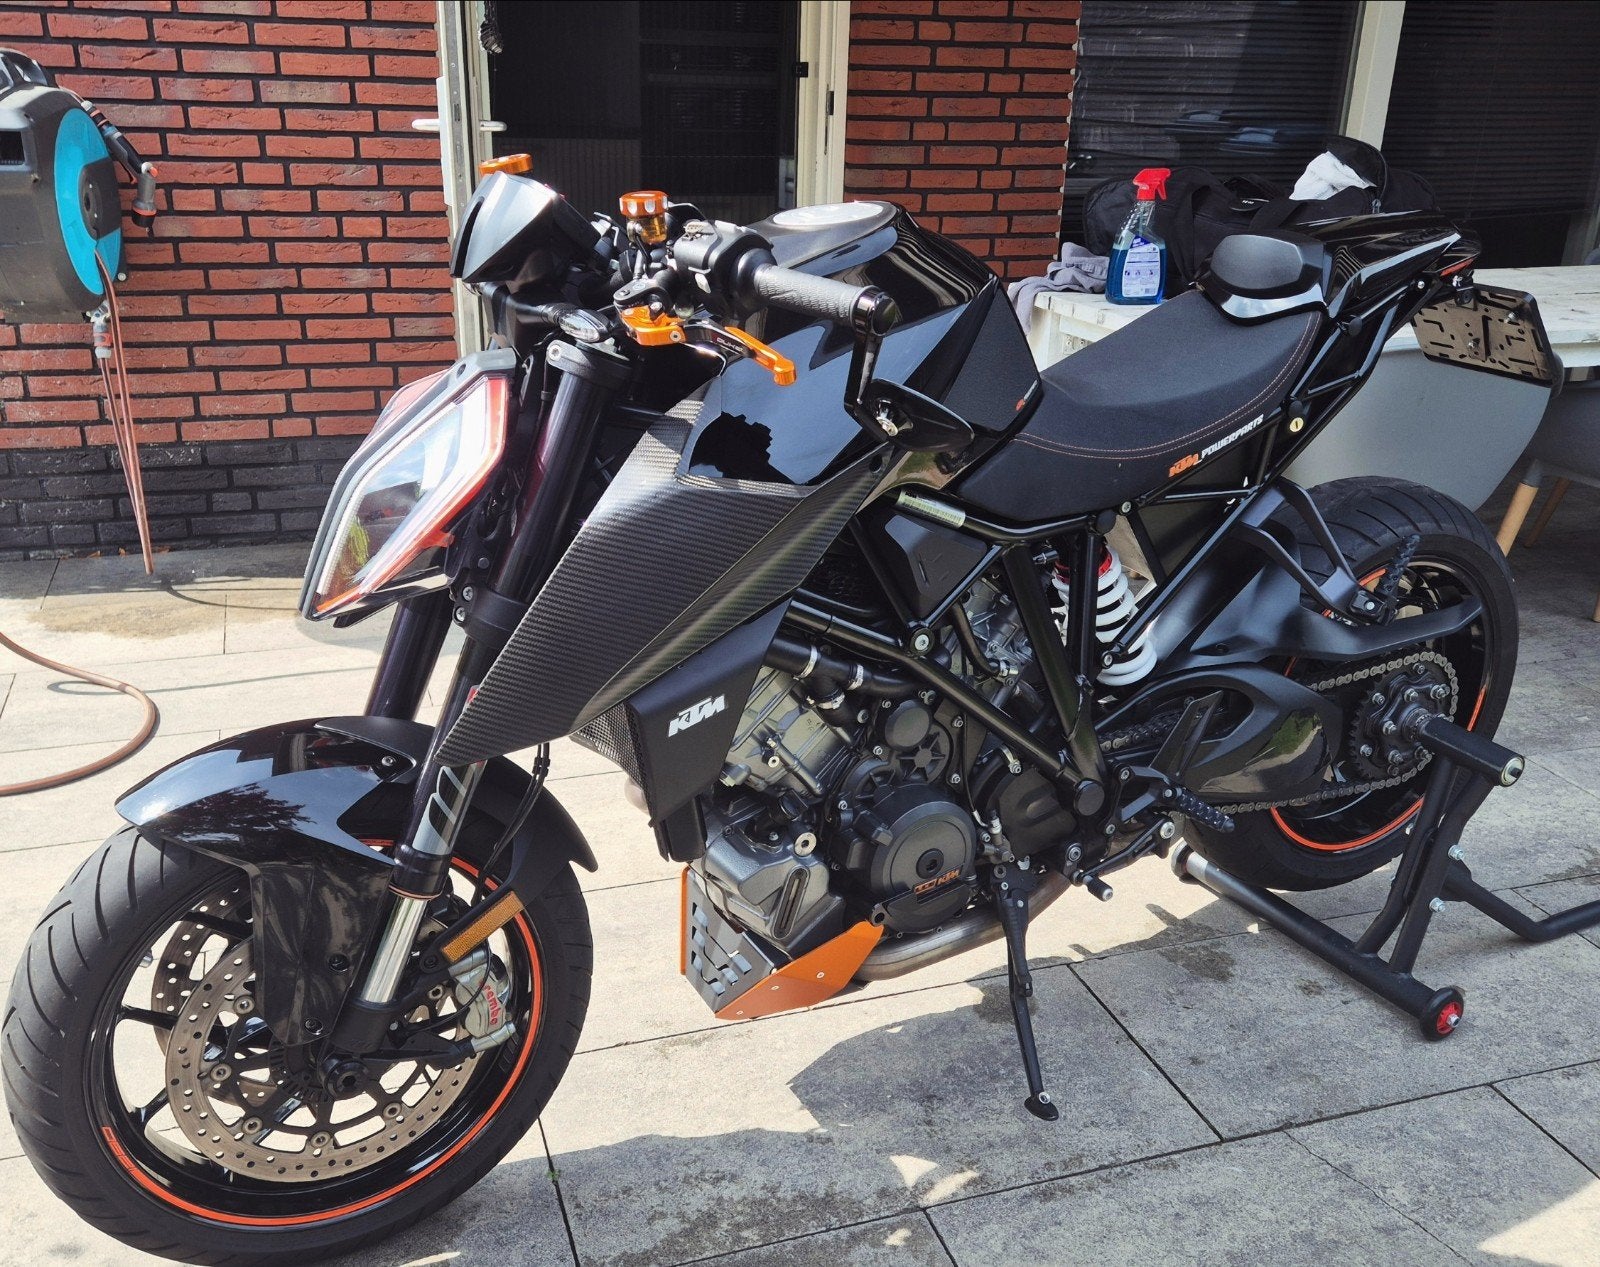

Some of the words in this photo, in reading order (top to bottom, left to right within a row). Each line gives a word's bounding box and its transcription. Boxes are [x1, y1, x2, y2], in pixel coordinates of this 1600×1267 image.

[1168, 453, 1199, 478] KTM
[1201, 413, 1264, 459] POWERPARTS
[668, 694, 726, 738] KTM
[478, 980, 502, 1026] rembo
